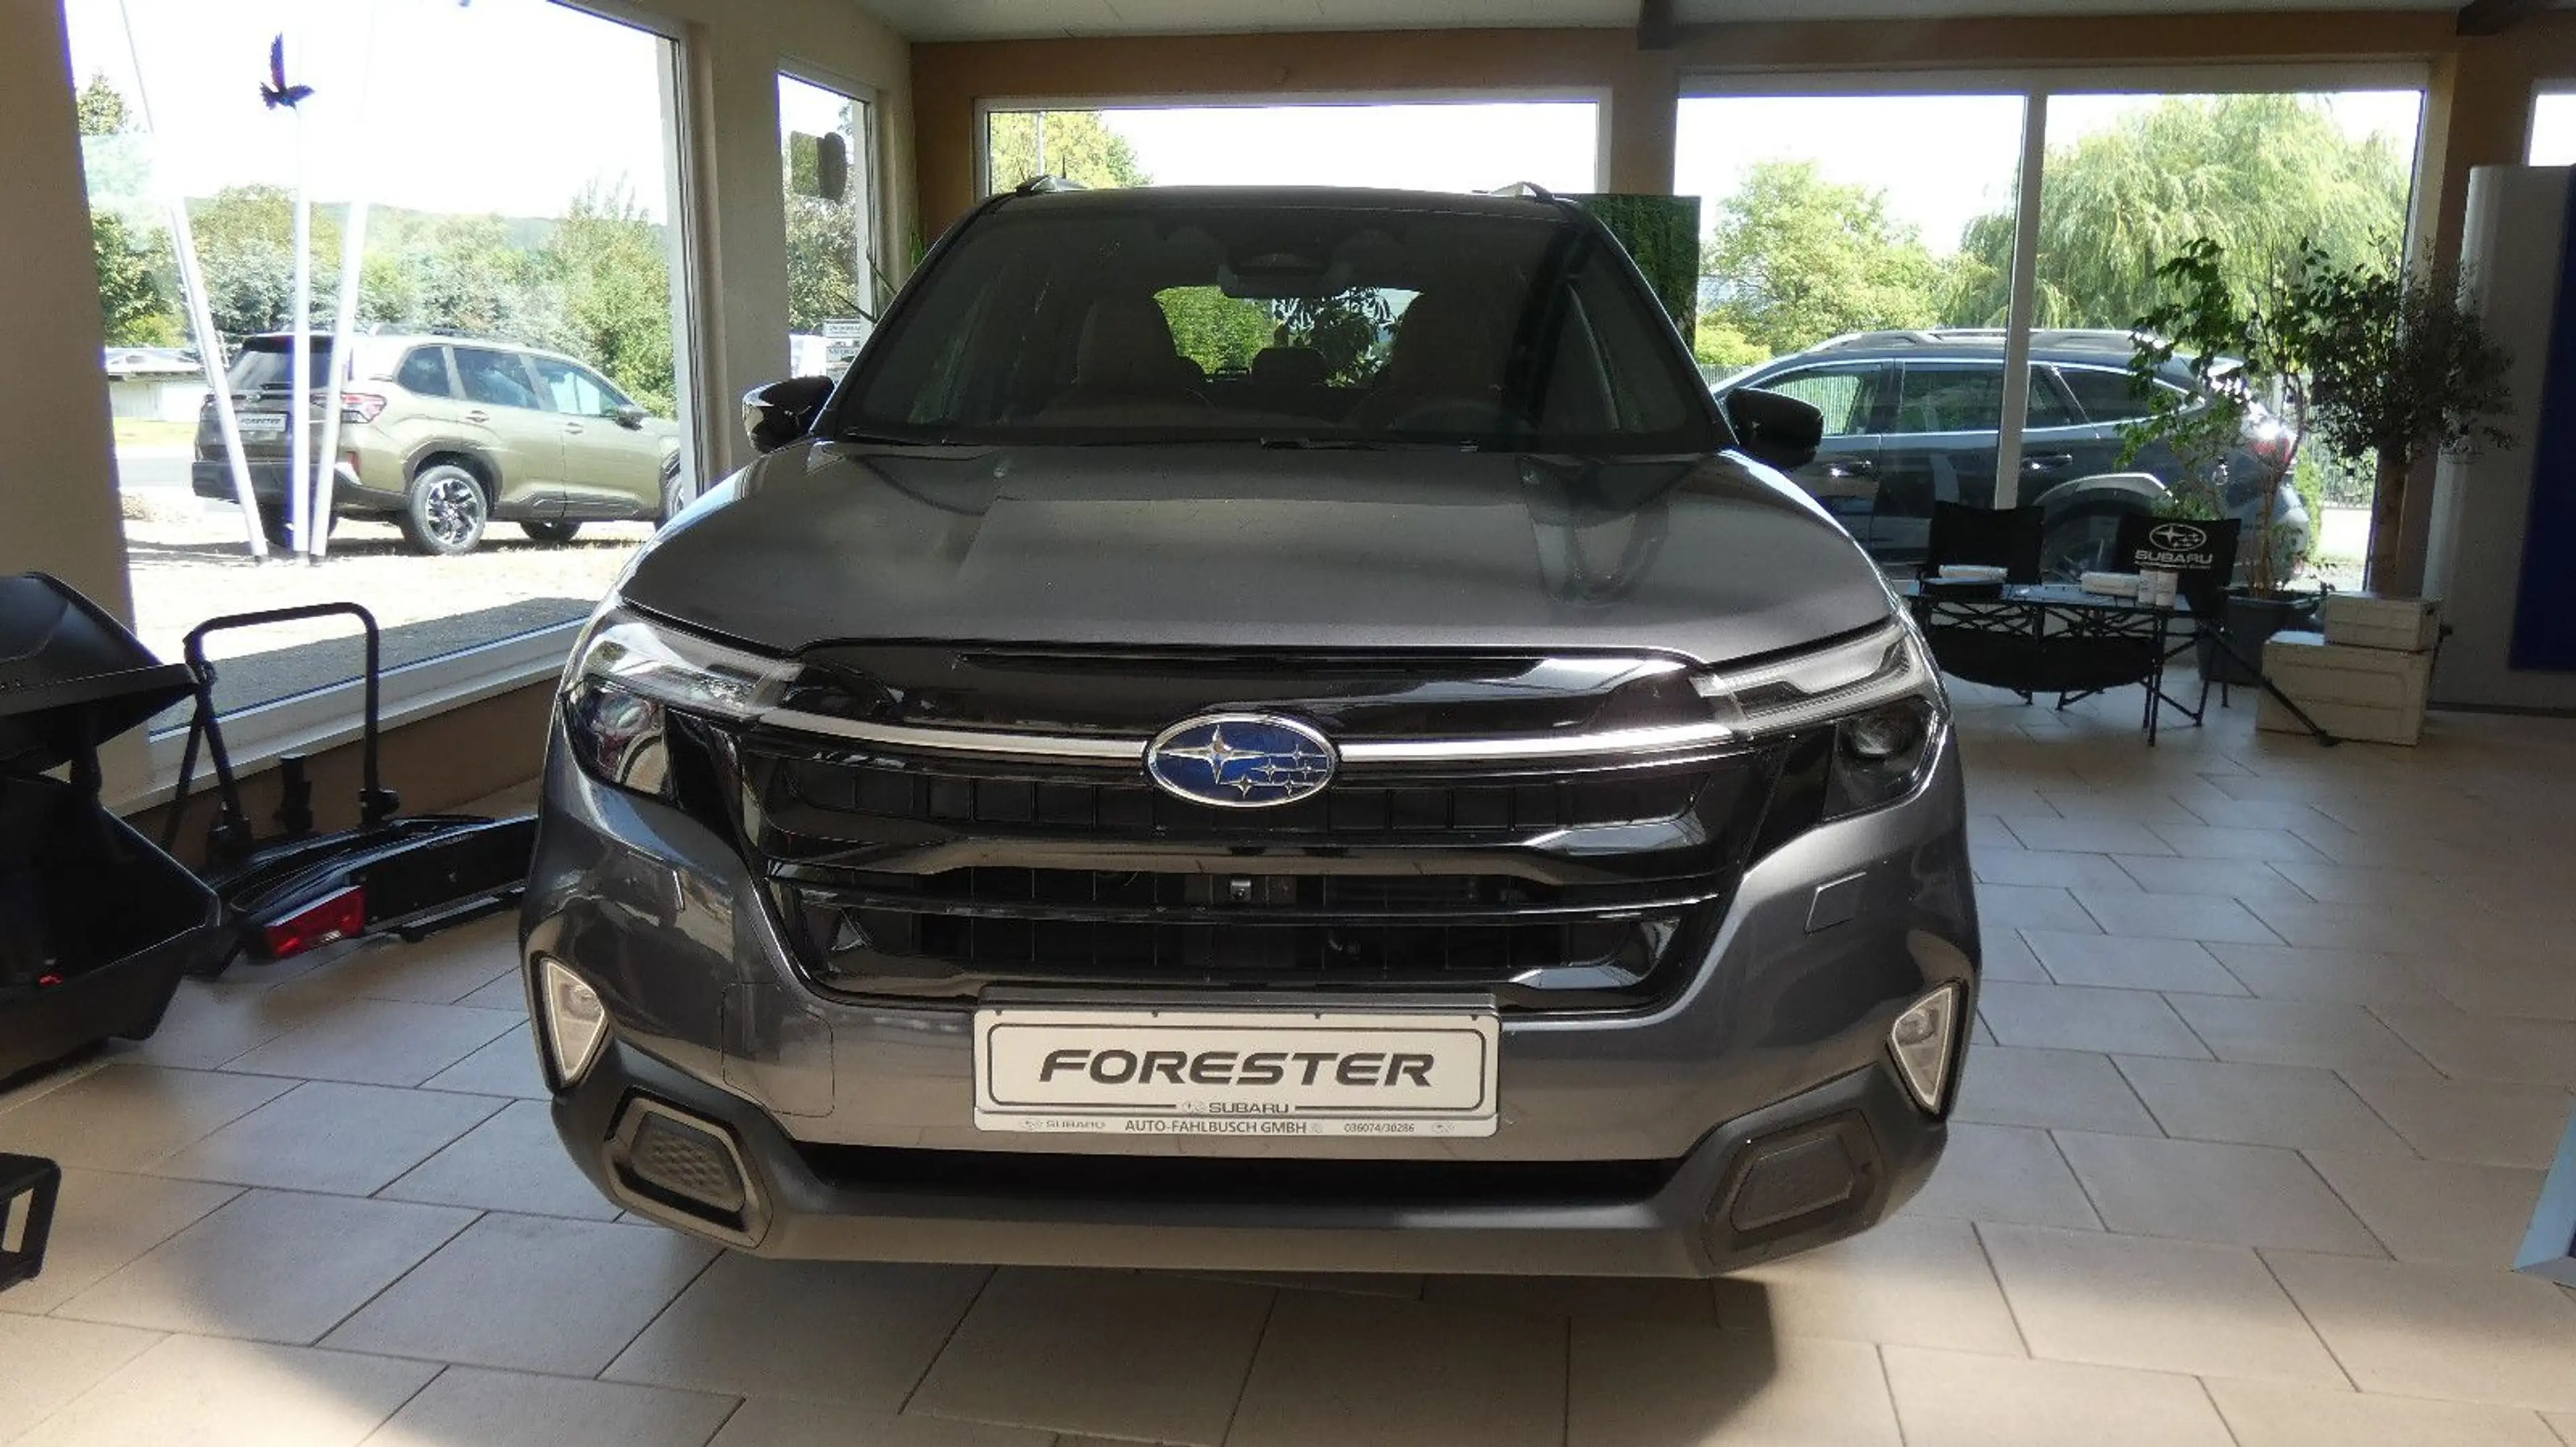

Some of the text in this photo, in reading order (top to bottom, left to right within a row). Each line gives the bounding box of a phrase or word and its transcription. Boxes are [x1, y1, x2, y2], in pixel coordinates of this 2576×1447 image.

[2135, 549, 2213, 564] SUBARU
[1039, 1049, 1434, 1087] FORESTER
[1209, 1102, 1289, 1114] SUBARU
[1125, 1120, 1307, 1134] AUTO-FAHLBUSCH GMBH
